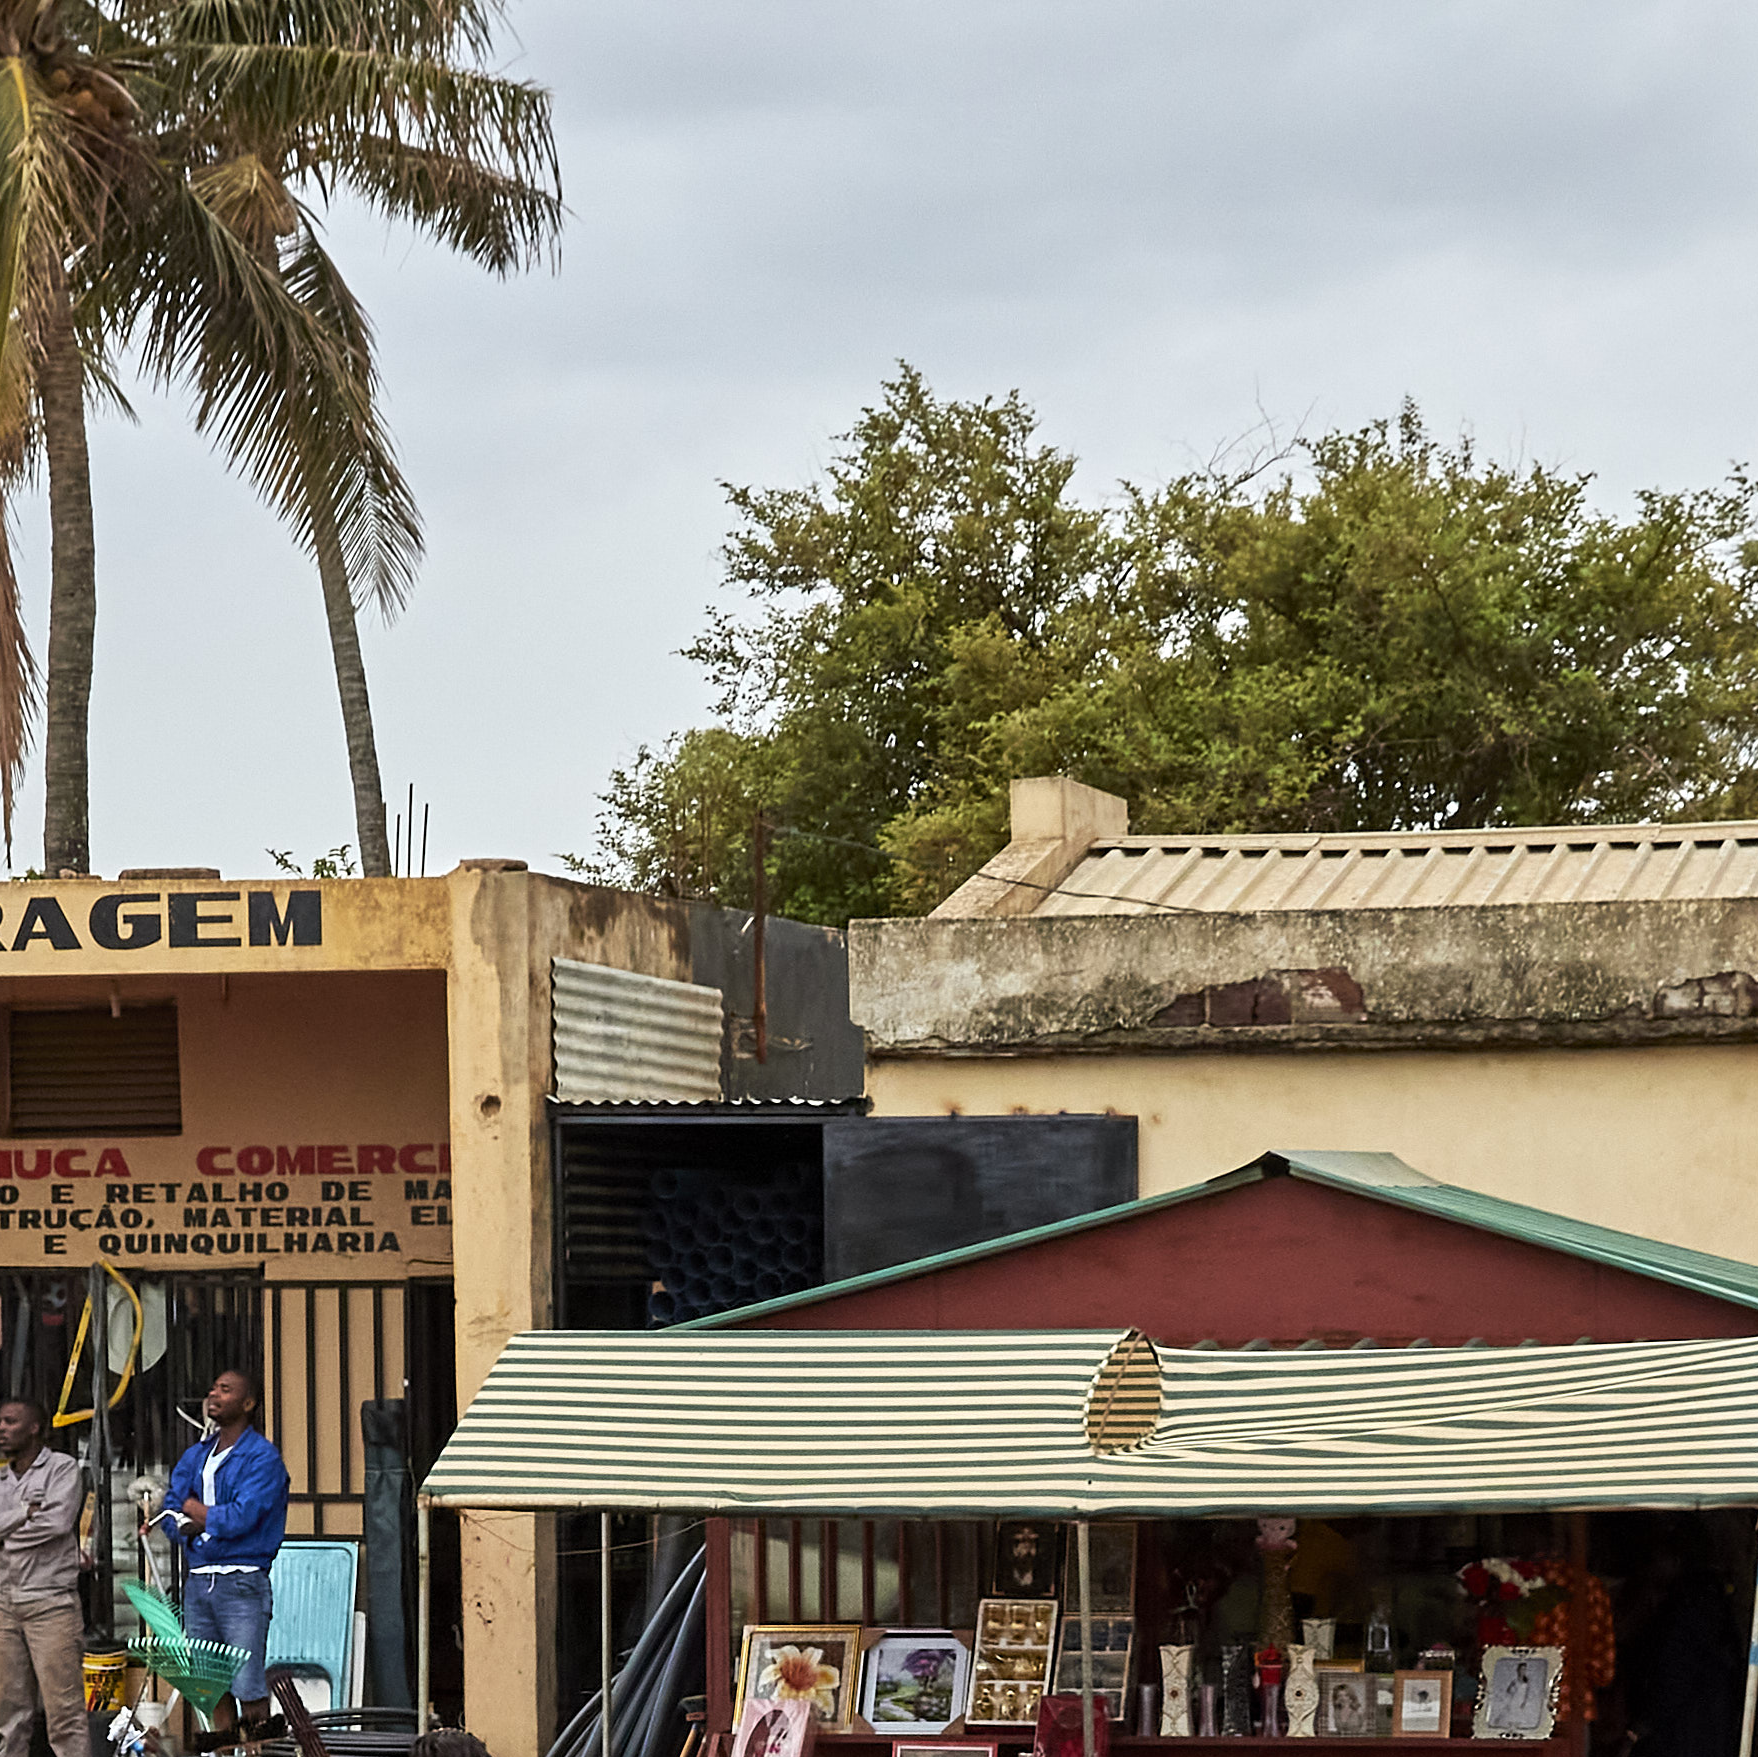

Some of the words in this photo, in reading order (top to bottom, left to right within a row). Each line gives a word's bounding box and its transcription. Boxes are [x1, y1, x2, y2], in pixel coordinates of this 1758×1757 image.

[51, 1184, 74, 1204] E
[106, 1181, 289, 1203] RETALHO
[321, 1180, 372, 1201] DE
[183, 1206, 374, 1228] MATERIAL
[44, 1234, 67, 1254] E
[99, 1232, 401, 1255] QUINQUILHARIA
